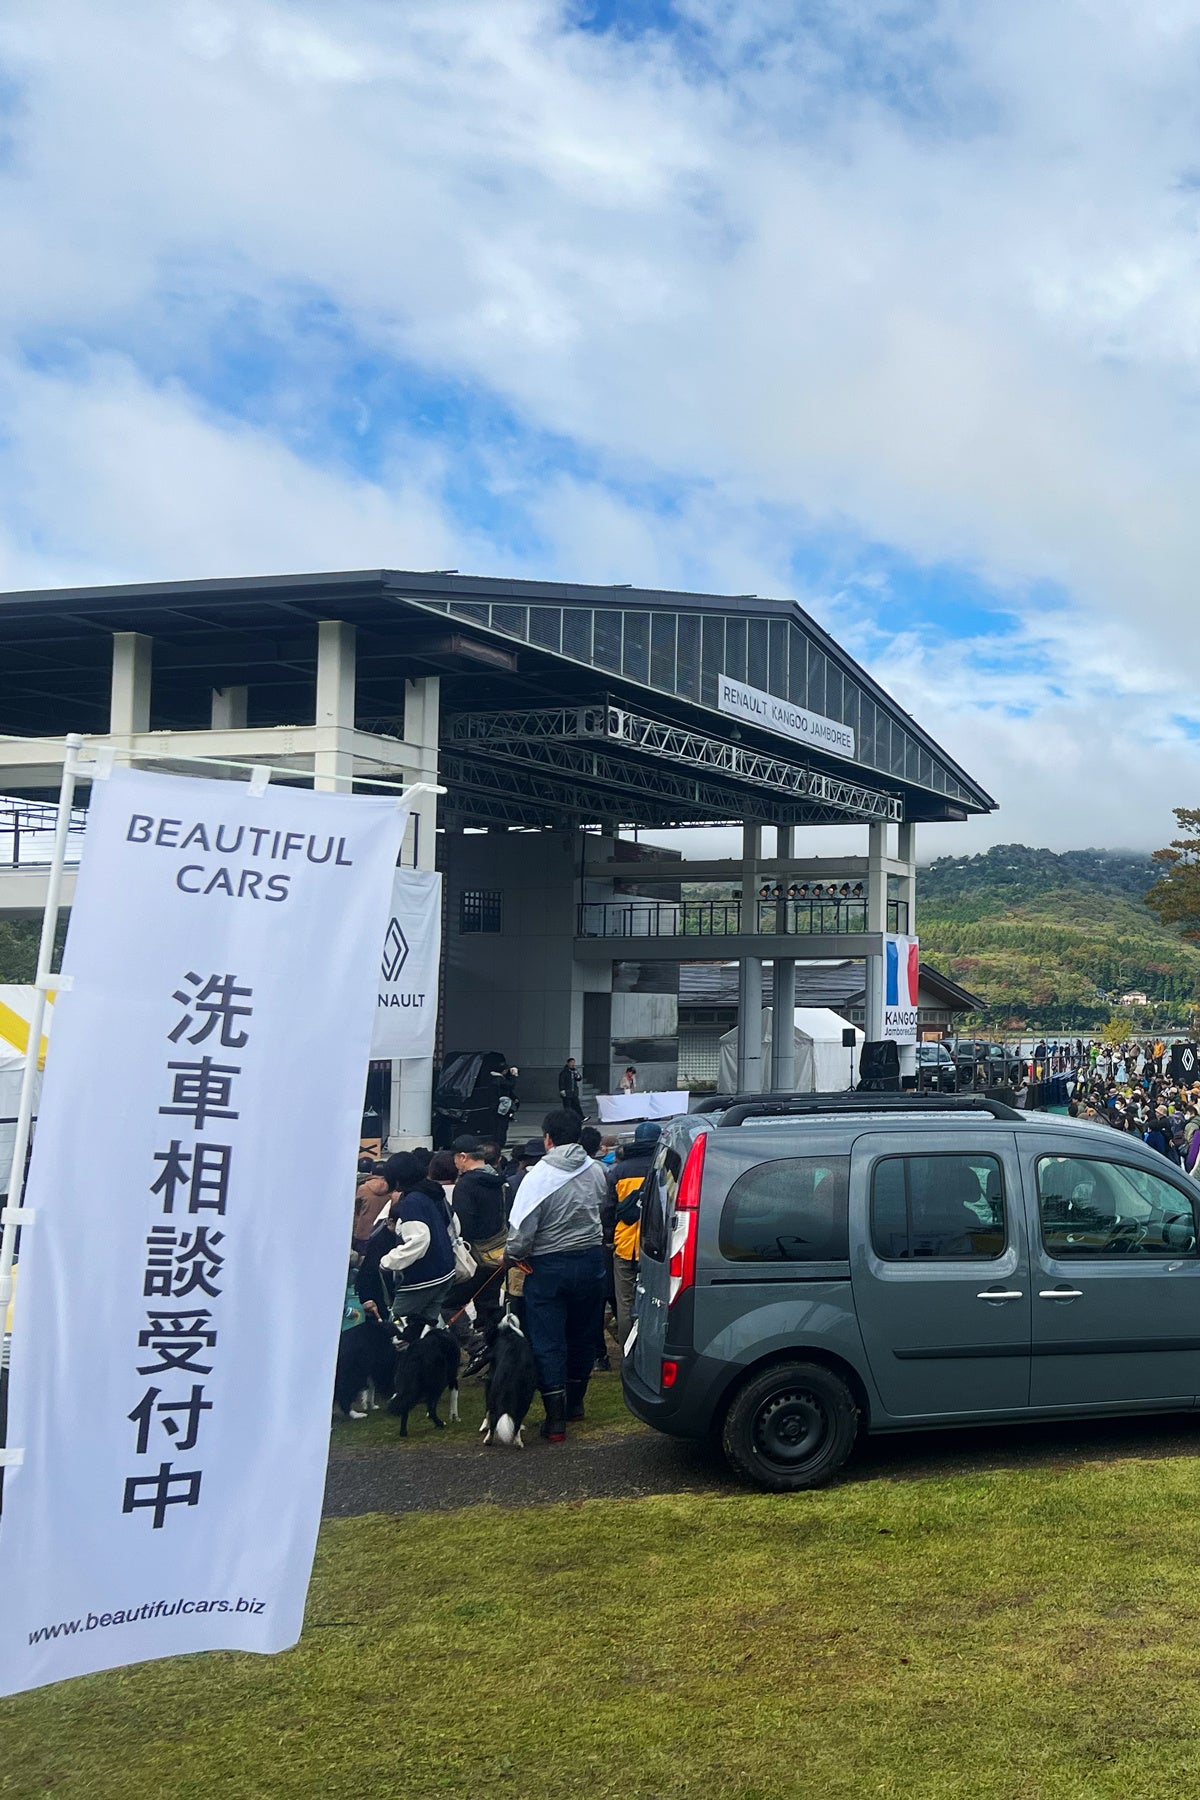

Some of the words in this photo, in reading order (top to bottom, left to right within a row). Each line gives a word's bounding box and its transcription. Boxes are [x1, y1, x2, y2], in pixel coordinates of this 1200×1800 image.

[724, 686, 768, 716] RENAULT
[772, 706, 808, 732] KANGOO
[810, 723, 852, 748] JAMBOREE
[126, 813, 354, 867] BEAUTIFUL
[176, 864, 292, 903] CARS
[377, 993, 426, 1008] NAULT
[121, 970, 254, 1530] 洗車相談受付中
[27, 1597, 266, 1646] www.beautifulcars.biz
